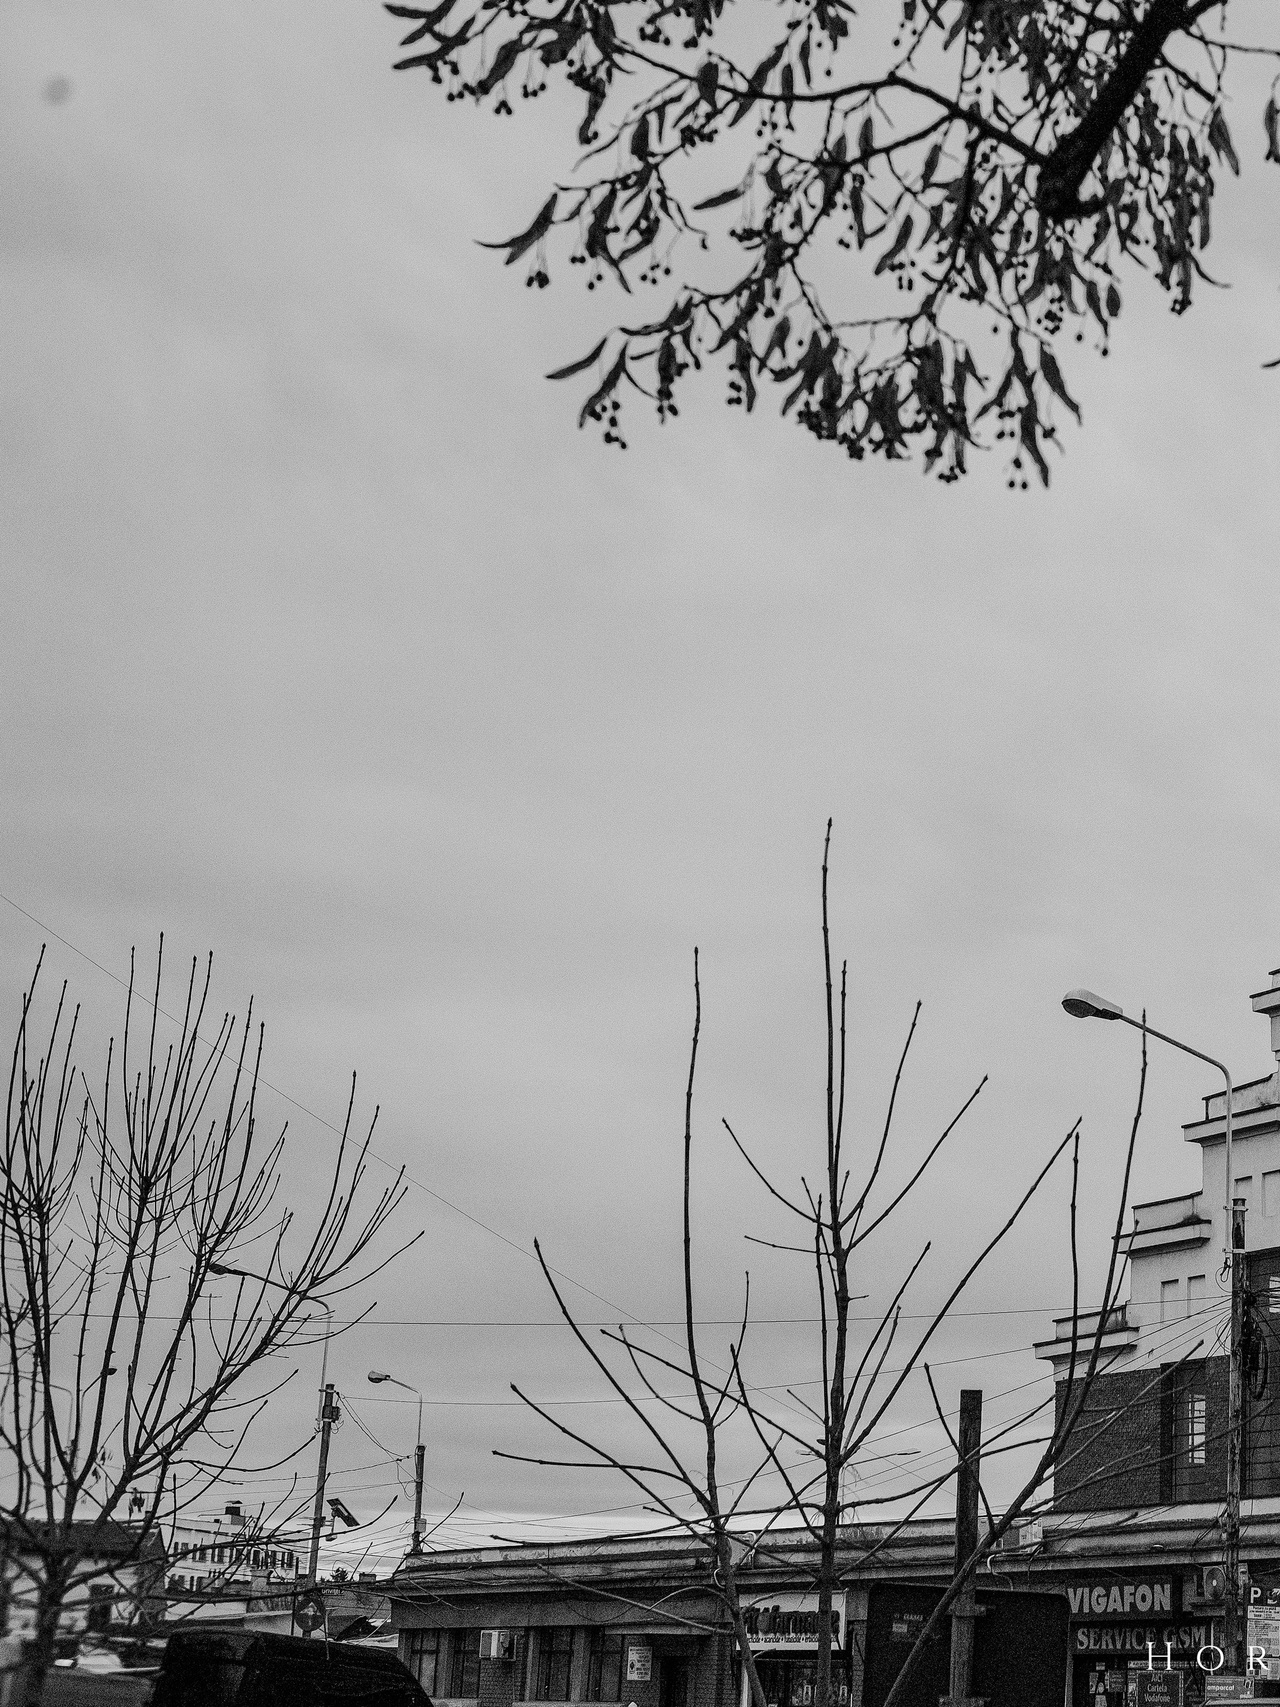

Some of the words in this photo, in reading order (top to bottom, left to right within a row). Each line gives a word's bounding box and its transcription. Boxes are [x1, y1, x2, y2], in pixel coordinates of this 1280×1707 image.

[1067, 1583, 1171, 1614] VIGAFON
[1250, 1587, 1262, 1604] P
[1077, 1626, 1156, 1650] SERVICE
[1163, 1625, 1206, 1650] GSM
[1147, 1683, 1168, 1692] Cartela
[1144, 1693, 1170, 1702] Vodafone
